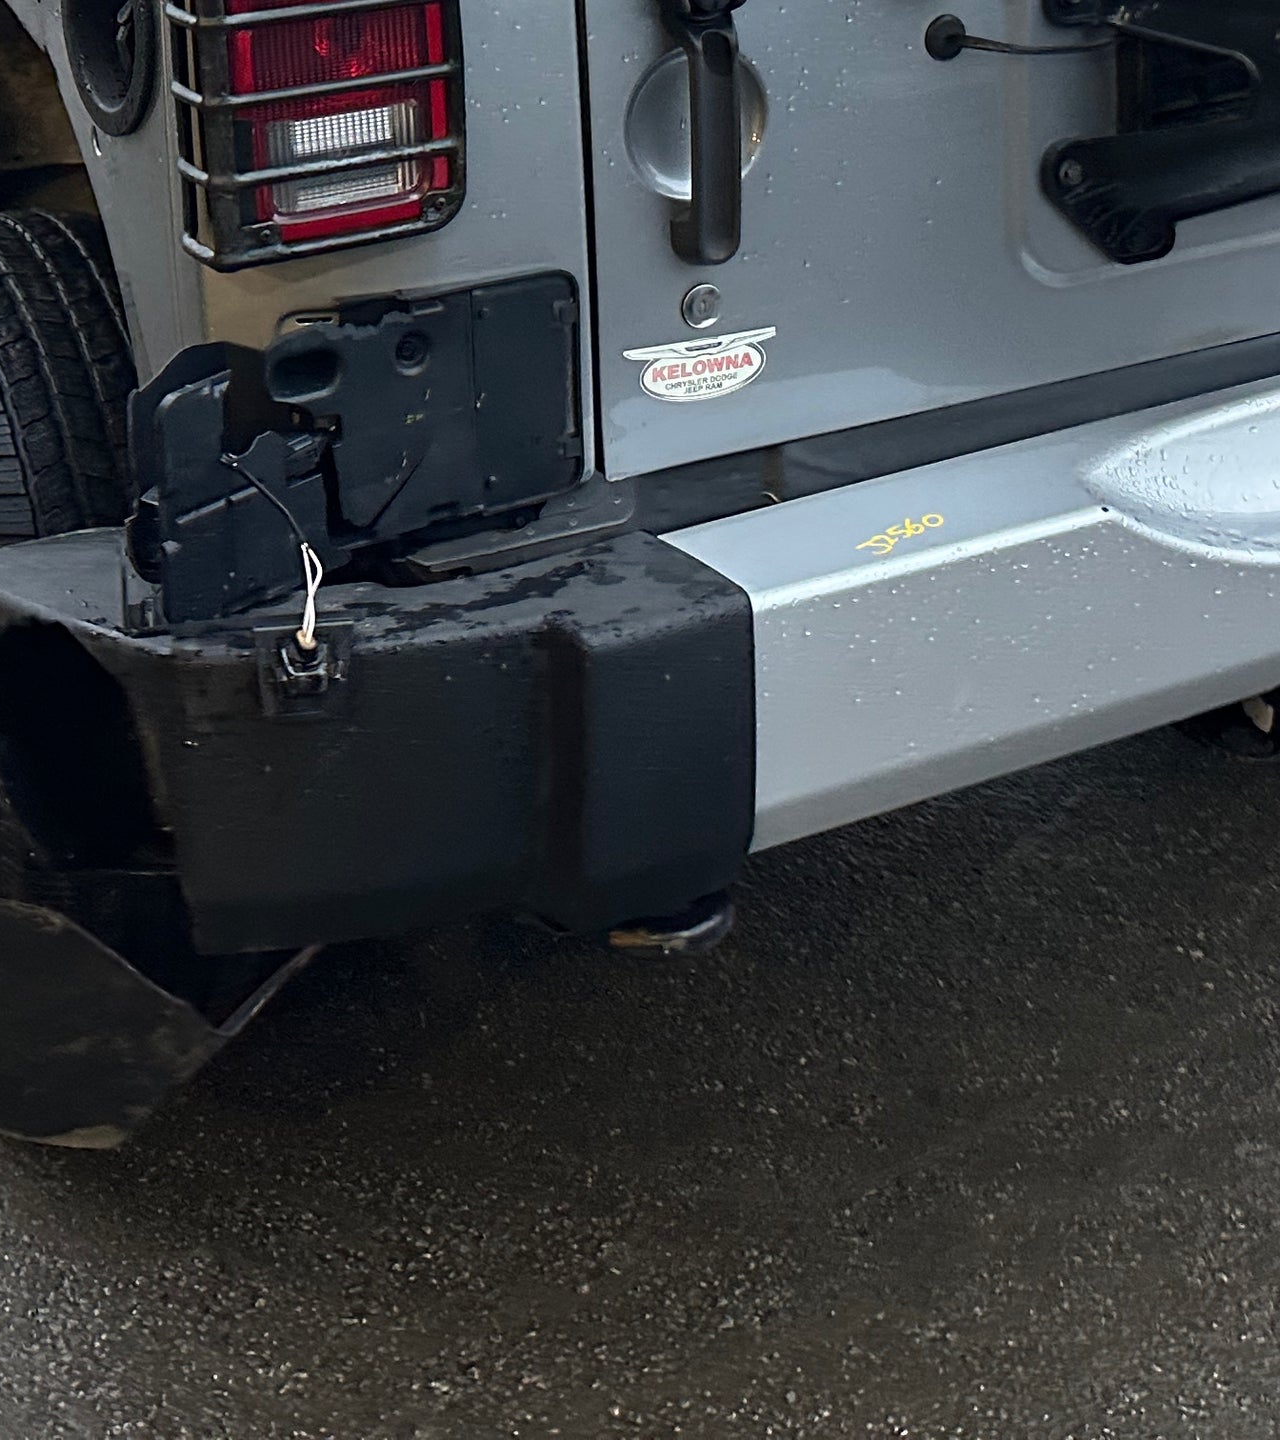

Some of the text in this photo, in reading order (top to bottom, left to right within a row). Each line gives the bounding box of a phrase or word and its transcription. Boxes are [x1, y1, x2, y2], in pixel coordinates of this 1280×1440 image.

[651, 352, 754, 382] KELOWNA
[665, 372, 738, 391] CHRYSLER DODGE
[705, 381, 723, 391] RAM
